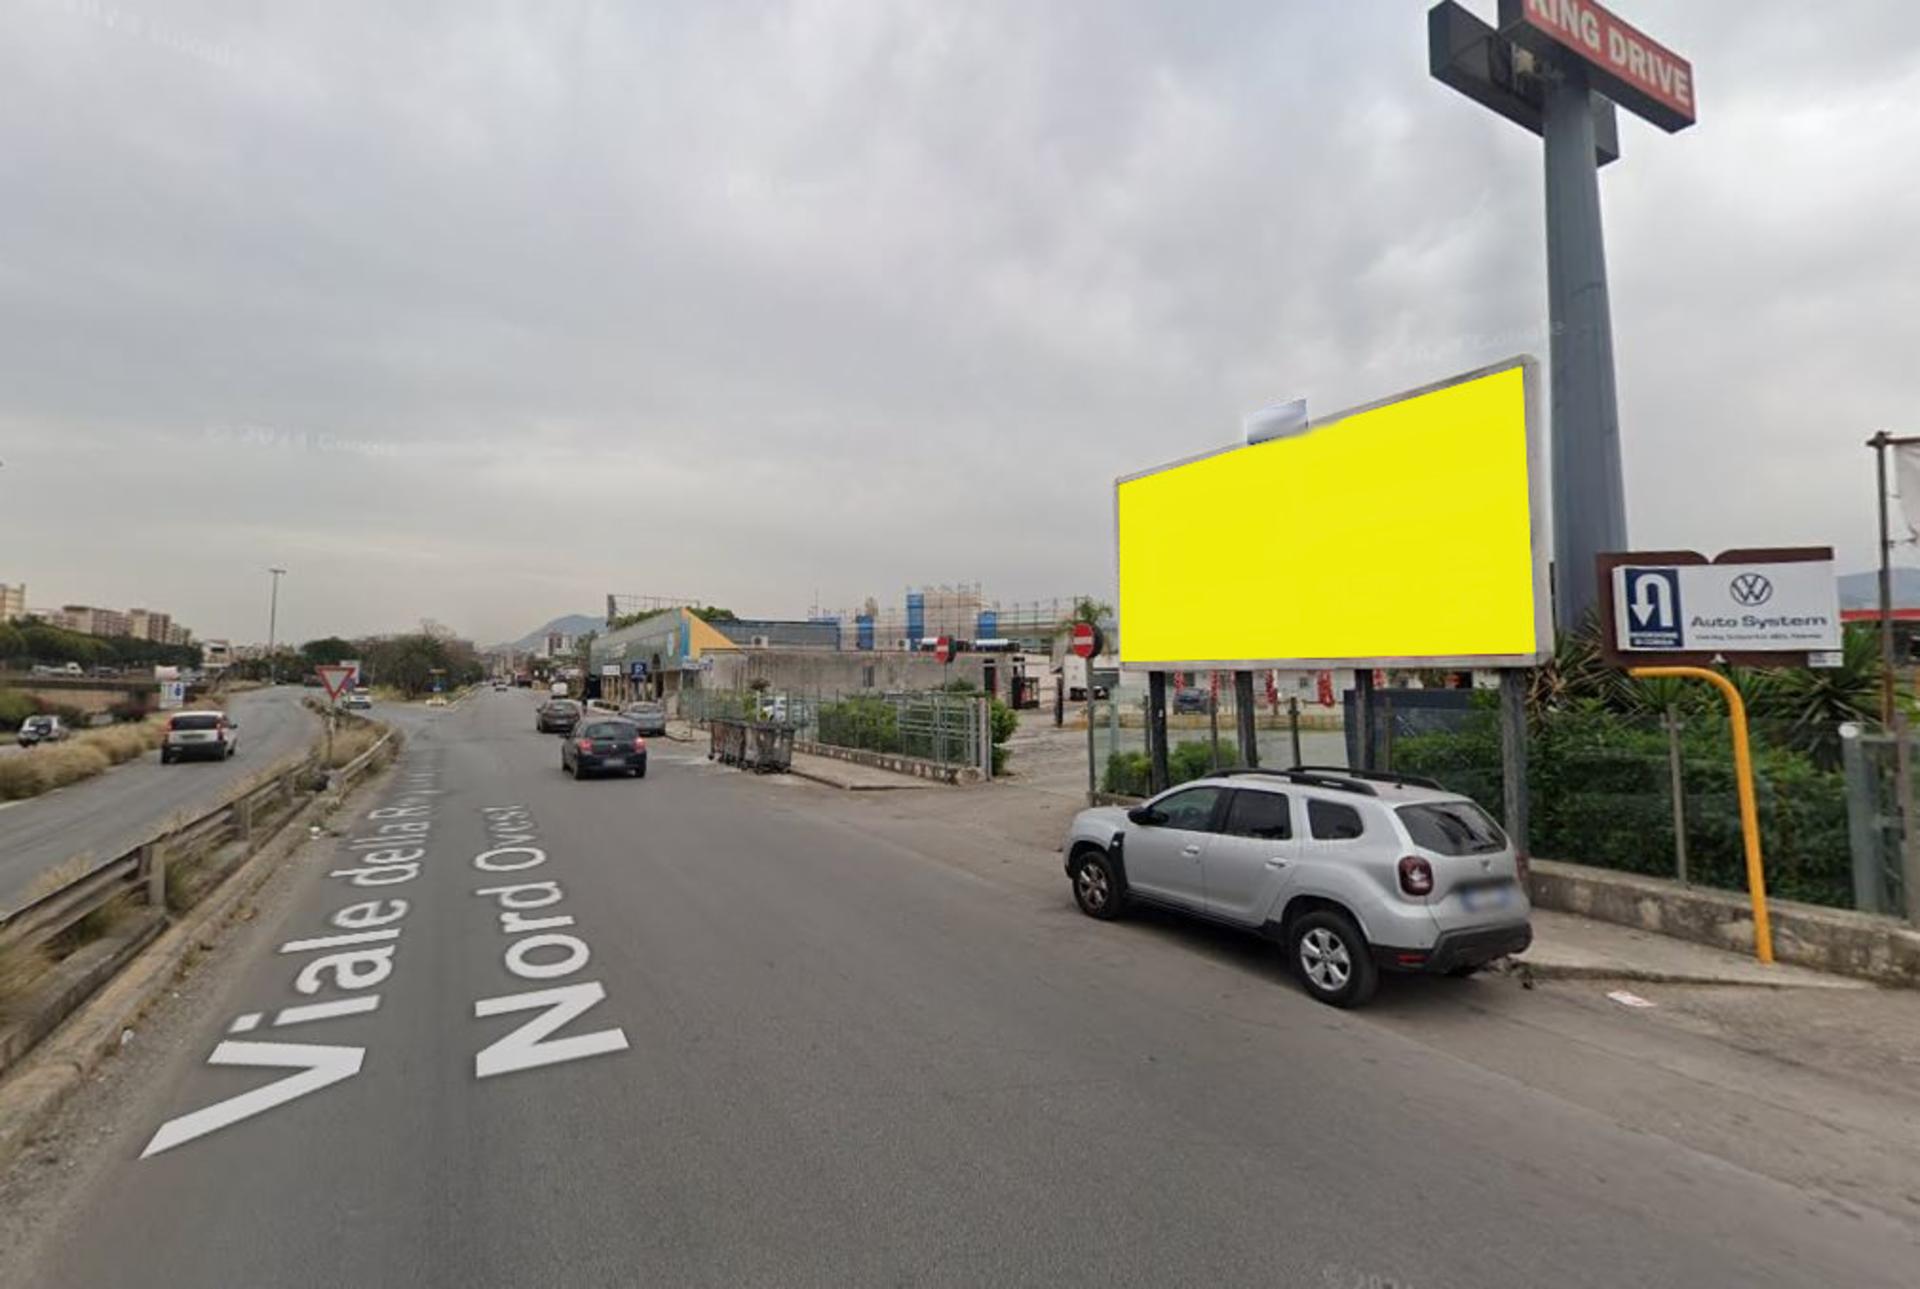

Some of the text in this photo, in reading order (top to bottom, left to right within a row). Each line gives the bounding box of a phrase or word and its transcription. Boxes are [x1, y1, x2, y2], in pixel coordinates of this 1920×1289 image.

[1608, 26, 1691, 106] DRIVE
[1691, 614, 1828, 630] Auto System
